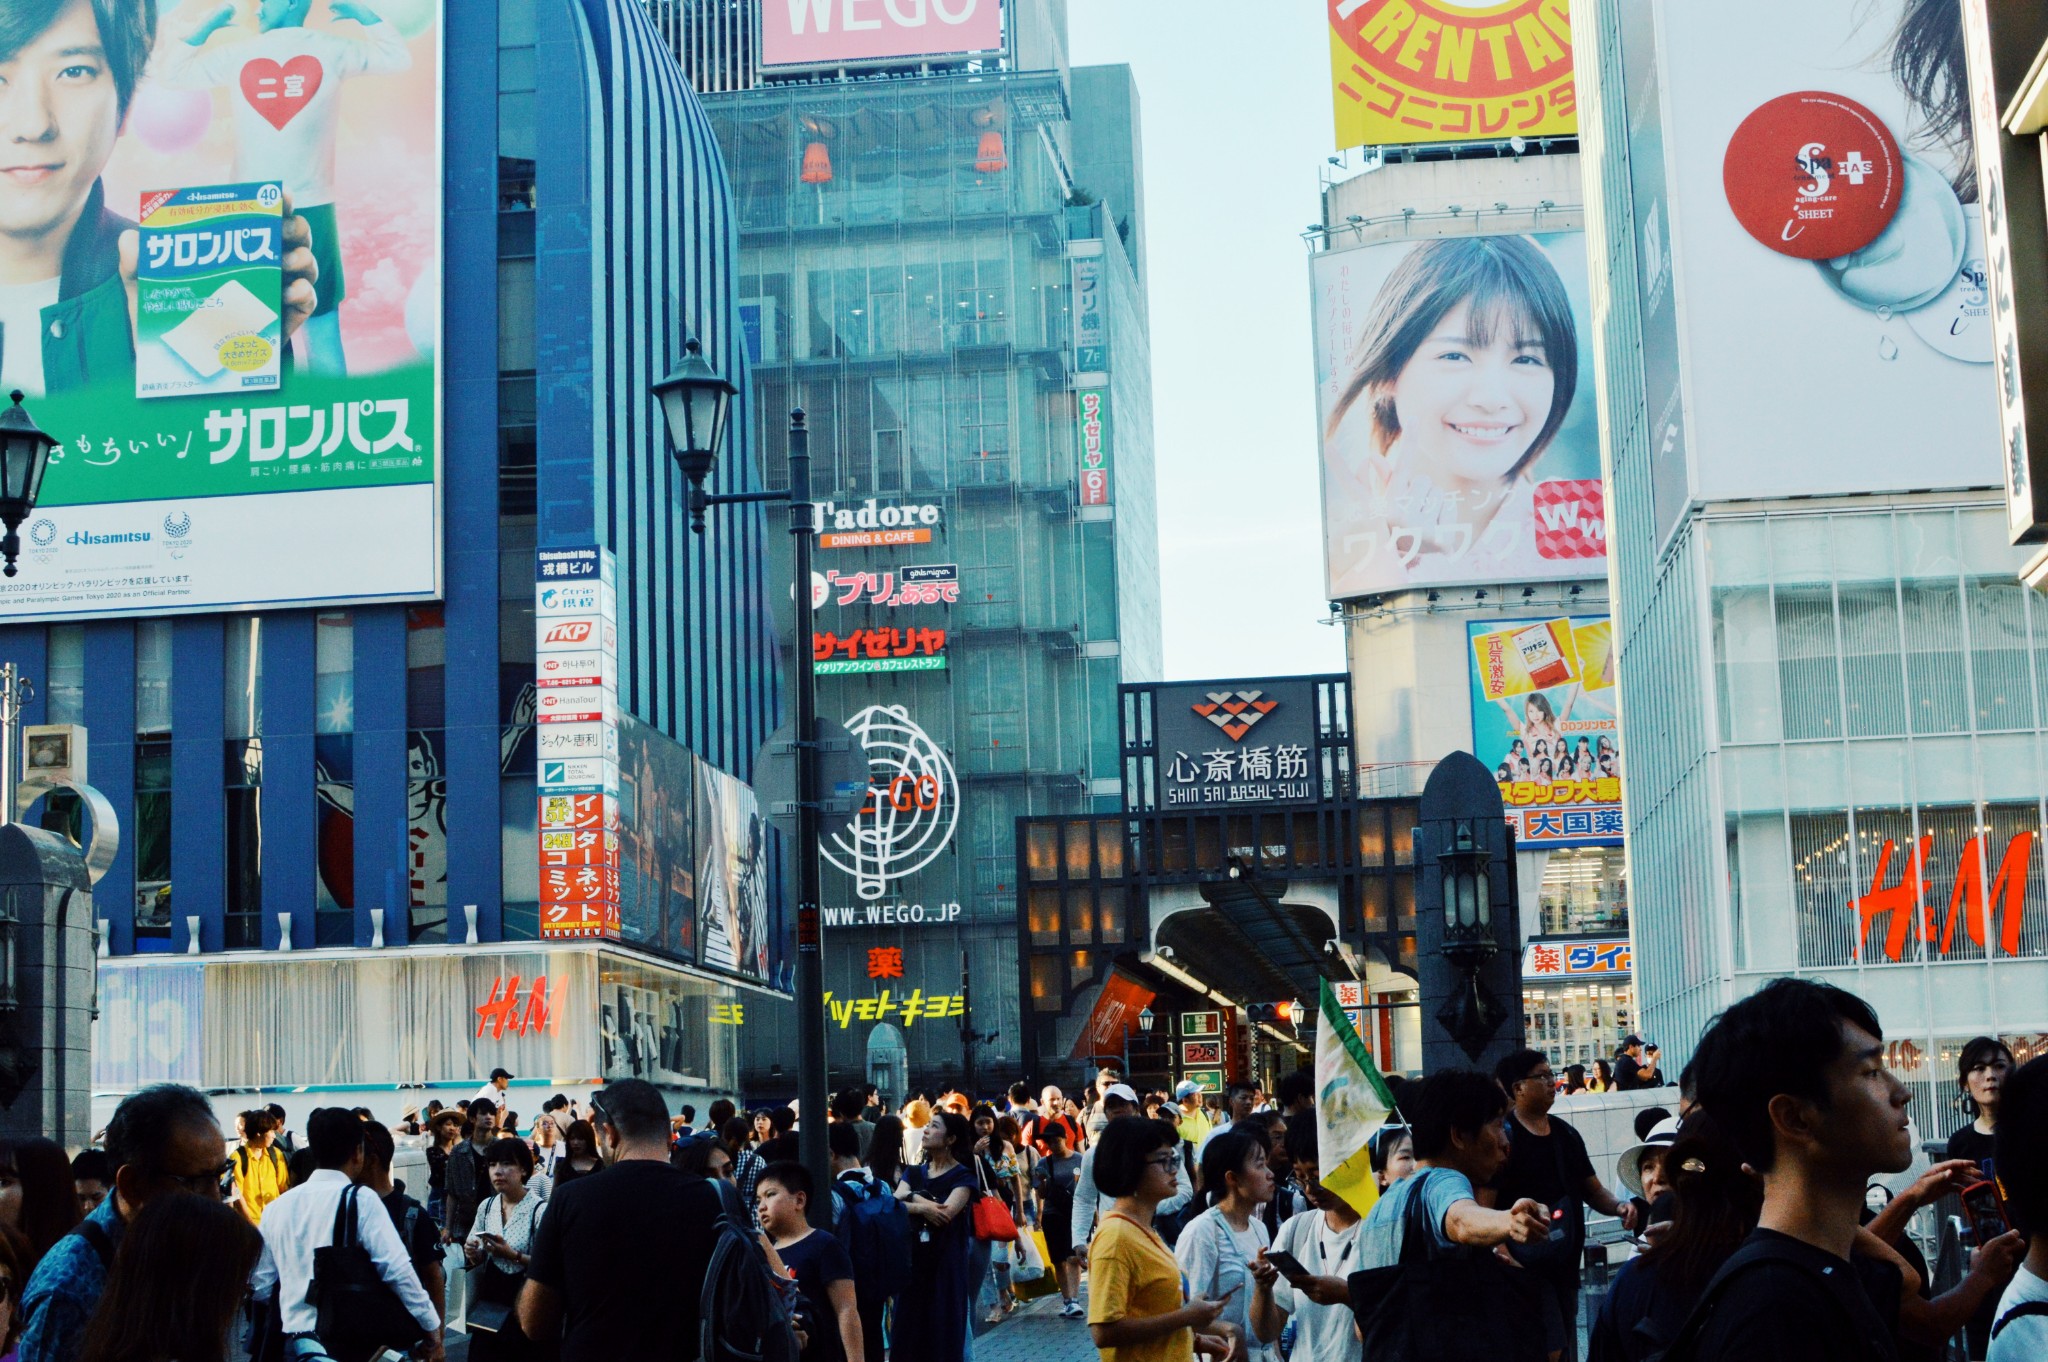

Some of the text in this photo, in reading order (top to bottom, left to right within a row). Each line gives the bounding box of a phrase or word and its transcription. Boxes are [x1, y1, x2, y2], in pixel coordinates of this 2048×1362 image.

[256, 74, 306, 99] 二宮
[1795, 154, 1832, 175] Spa
[260, 188, 278, 201] 40
[1798, 209, 1834, 220] SHEET
[146, 227, 274, 269] サロンパス
[1960, 267, 1987, 286] Sp
[1963, 308, 1989, 317] SHEE
[223, 349, 268, 360] 大きめサイズ
[1084, 348, 1101, 363] 7F
[204, 399, 413, 464] サロンパス
[1082, 394, 1103, 468] サイゼリヤ
[814, 499, 939, 534] J'adore
[66, 530, 151, 546] Hisamitsu
[831, 532, 915, 546] DINING & CAFE
[542, 561, 594, 576] 戎橋ビル
[549, 623, 589, 641] TKP
[814, 627, 946, 661] サイゼリヤ
[1487, 635, 1505, 695] 元気激安
[559, 695, 598, 705] HanaTour
[1166, 743, 1308, 784] 心斎橋筋
[1168, 787, 1199, 804] SHIN
[1204, 786, 1226, 802] SAI
[1499, 776, 1623, 806] スタッフ大募
[545, 806, 573, 822] 5F
[544, 832, 573, 849] 24H
[547, 851, 571, 922] コミック
[1847, 831, 2032, 962] H&M
[823, 903, 961, 926] WW.WEGO.JP
[867, 946, 904, 979] 薬
[1533, 943, 1561, 973] 薬
[1339, 983, 1358, 1005] 薬
[475, 974, 570, 1041] H&M
[824, 988, 972, 1029] ツモトキヨシ
